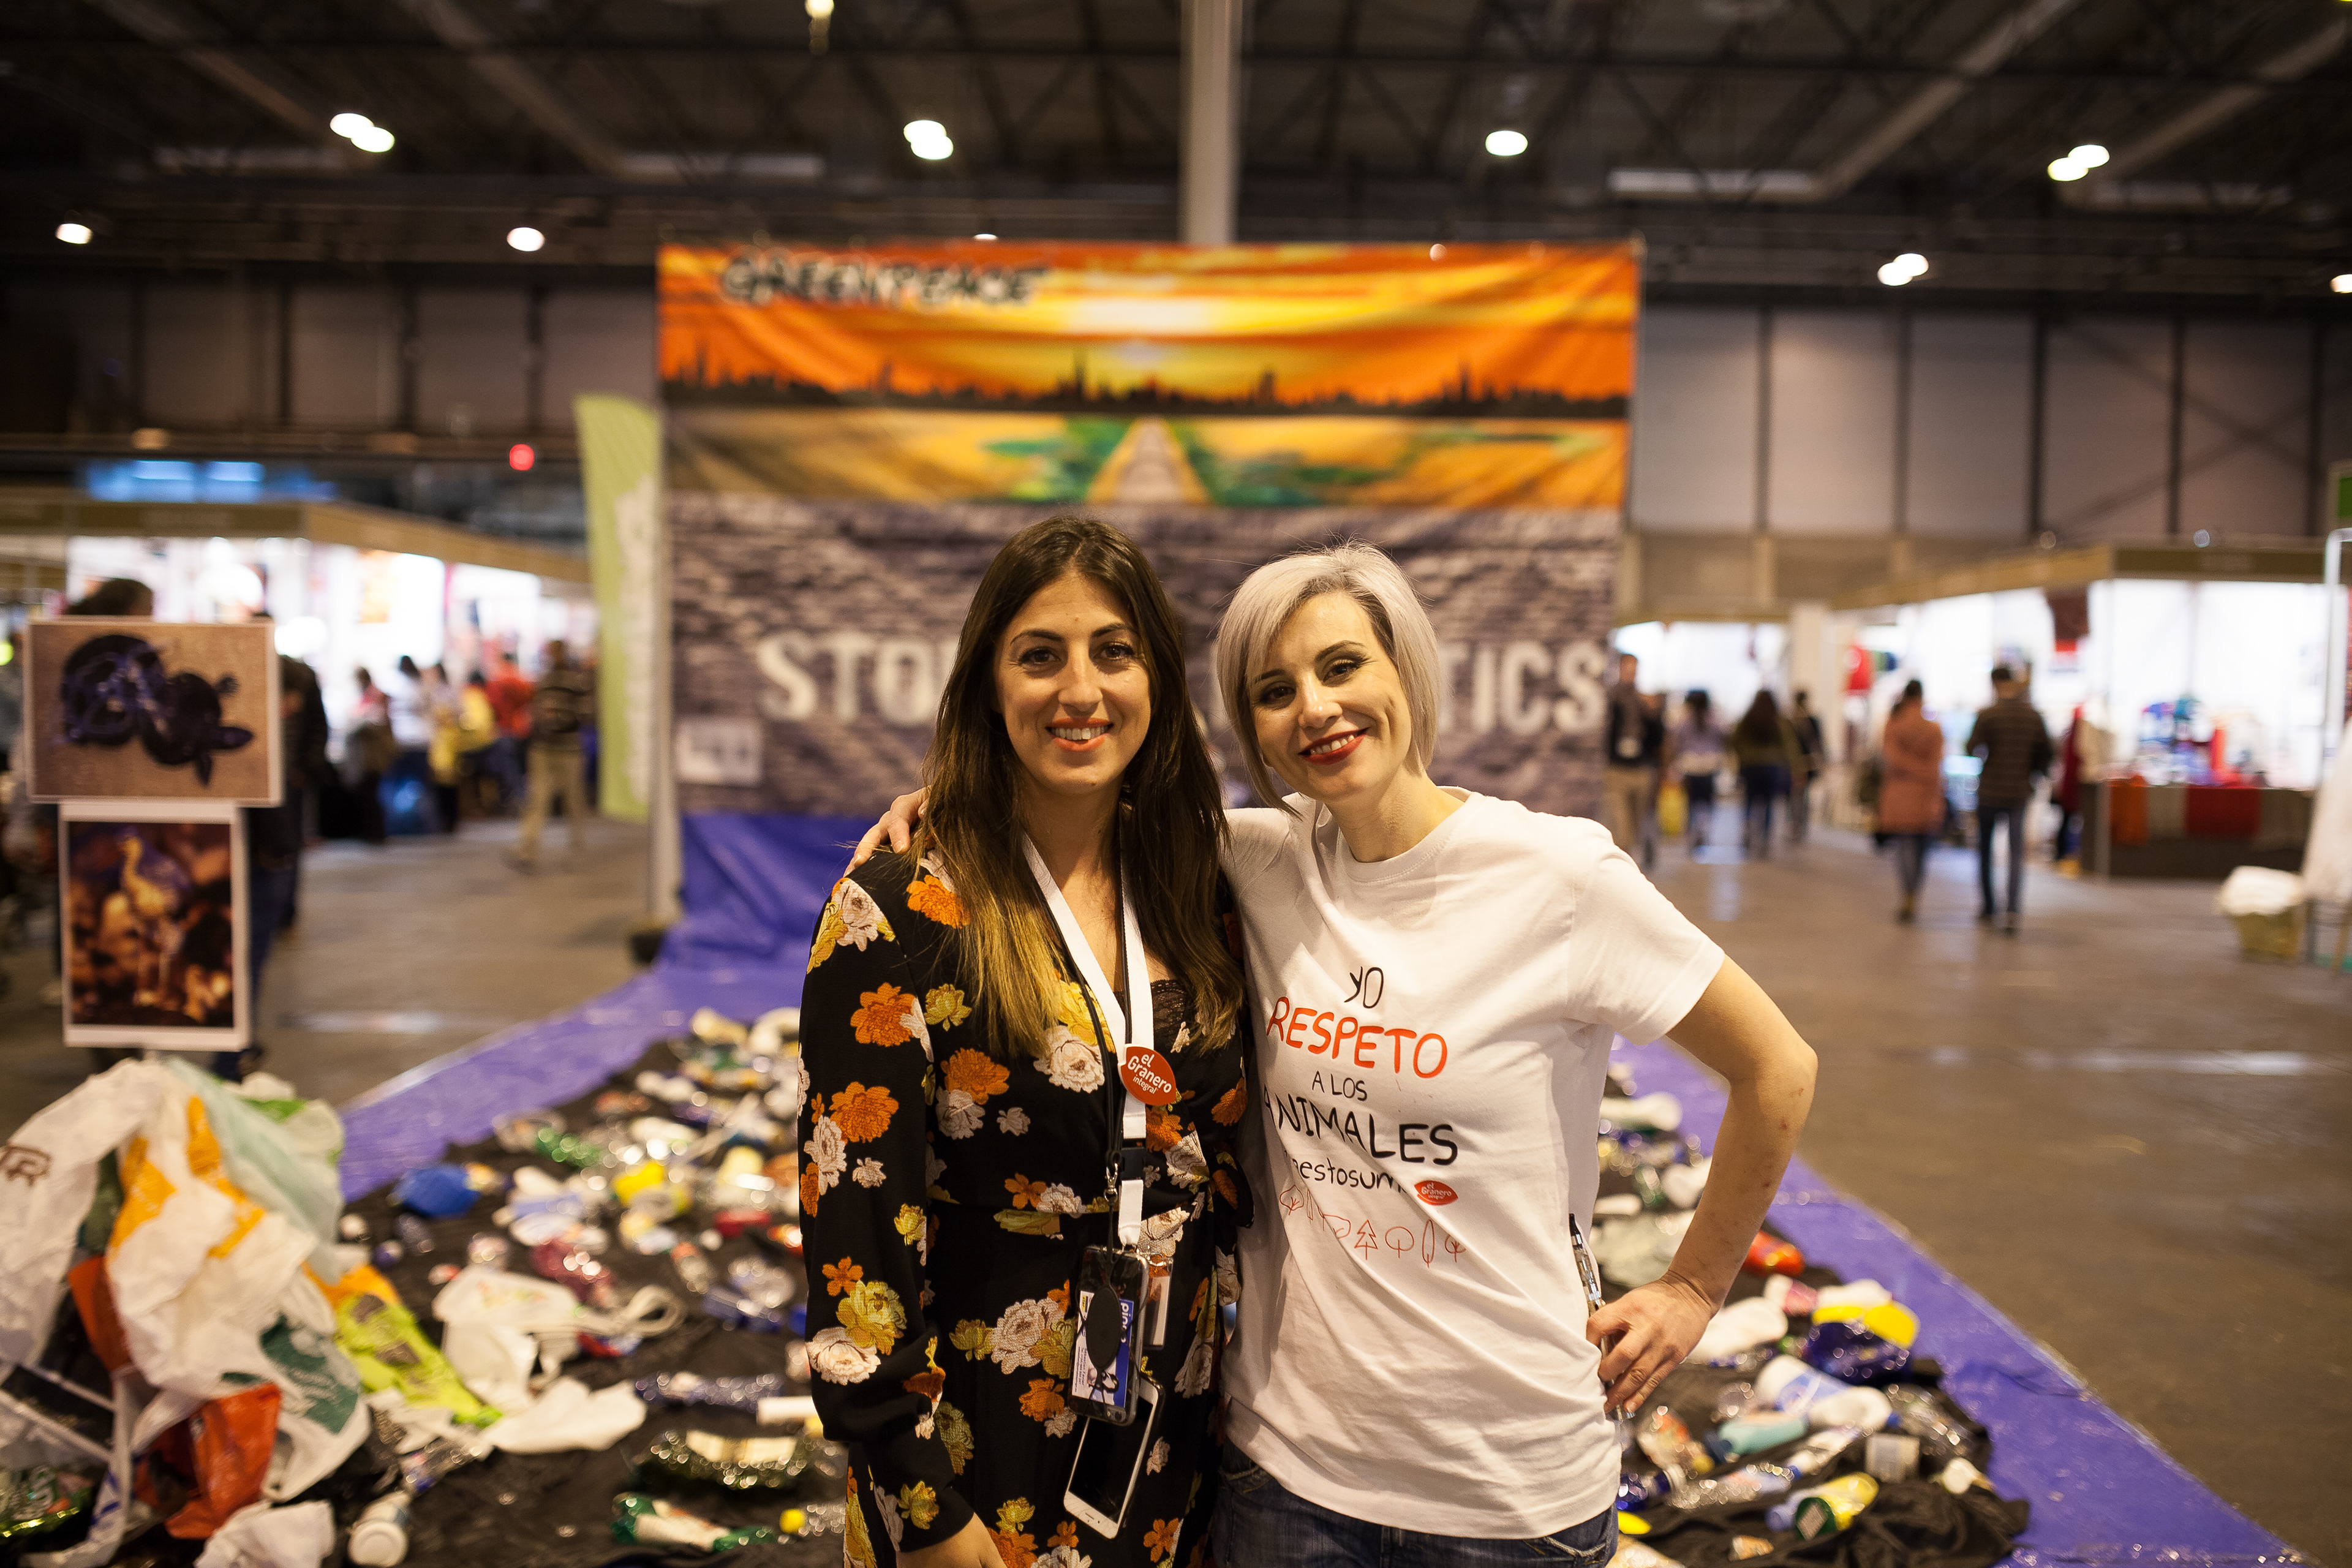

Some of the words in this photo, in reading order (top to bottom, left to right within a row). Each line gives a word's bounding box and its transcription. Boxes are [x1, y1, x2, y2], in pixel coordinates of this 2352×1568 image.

[723, 254, 1045, 307] GREENPEACE
[1437, 641, 1605, 734] TICS
[1266, 996, 1447, 1079] RESPETO
[1128, 1055, 1172, 1093] Granero
[1141, 1054, 1155, 1068] el
[1133, 1074, 1157, 1094] integral
[1312, 1071, 1325, 1093] A
[1330, 1074, 1368, 1101] LOS
[1264, 1084, 1458, 1166] ANIMALES
[1421, 1186, 1452, 1197] Granero
